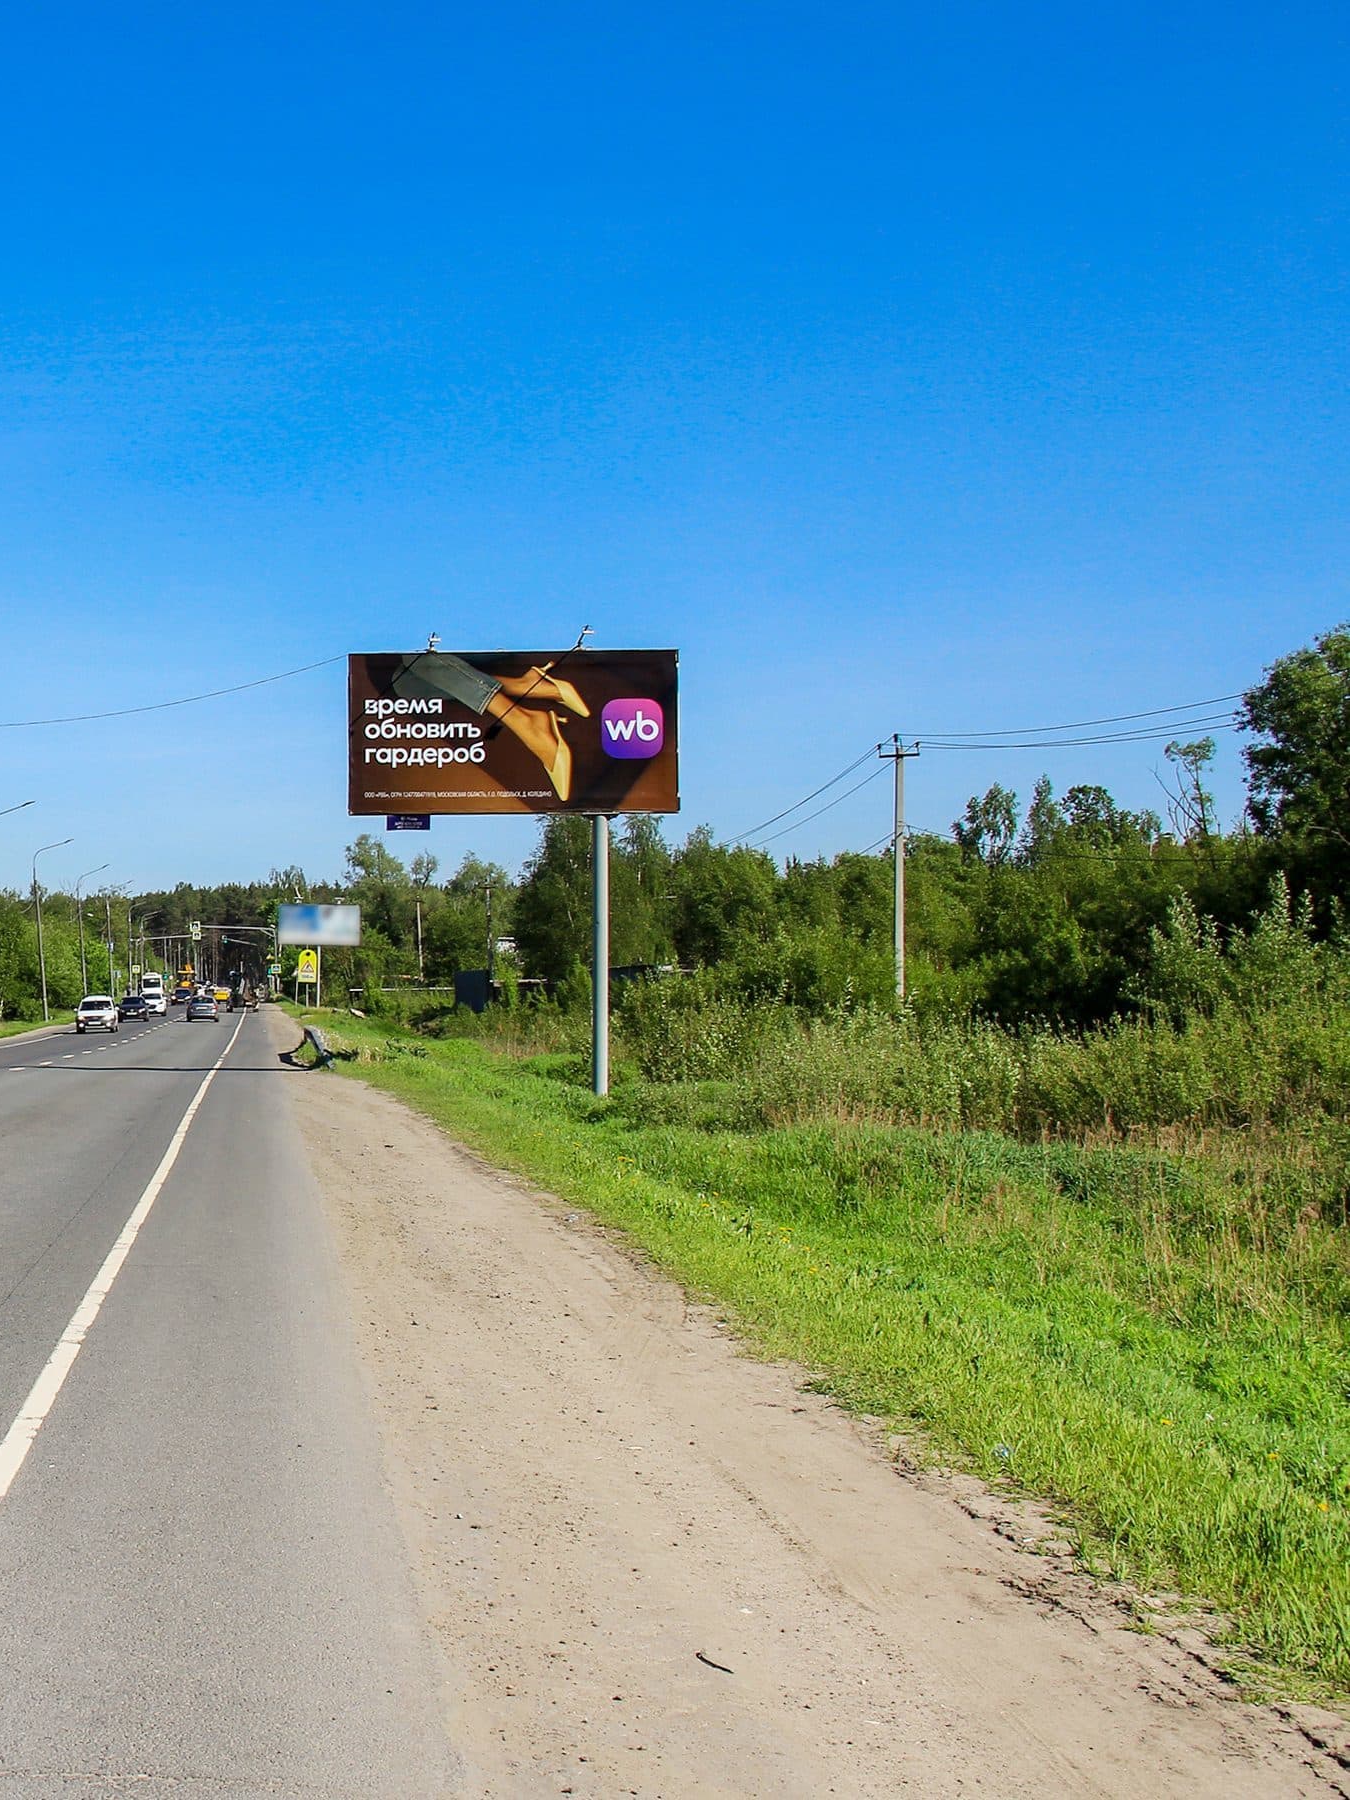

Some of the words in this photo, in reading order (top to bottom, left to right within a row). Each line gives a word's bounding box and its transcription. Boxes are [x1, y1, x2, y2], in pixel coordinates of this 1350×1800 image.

[364, 698, 443, 719] время
[364, 717, 482, 739] обновить
[605, 710, 659, 741] wb
[364, 741, 486, 768] гардероб
